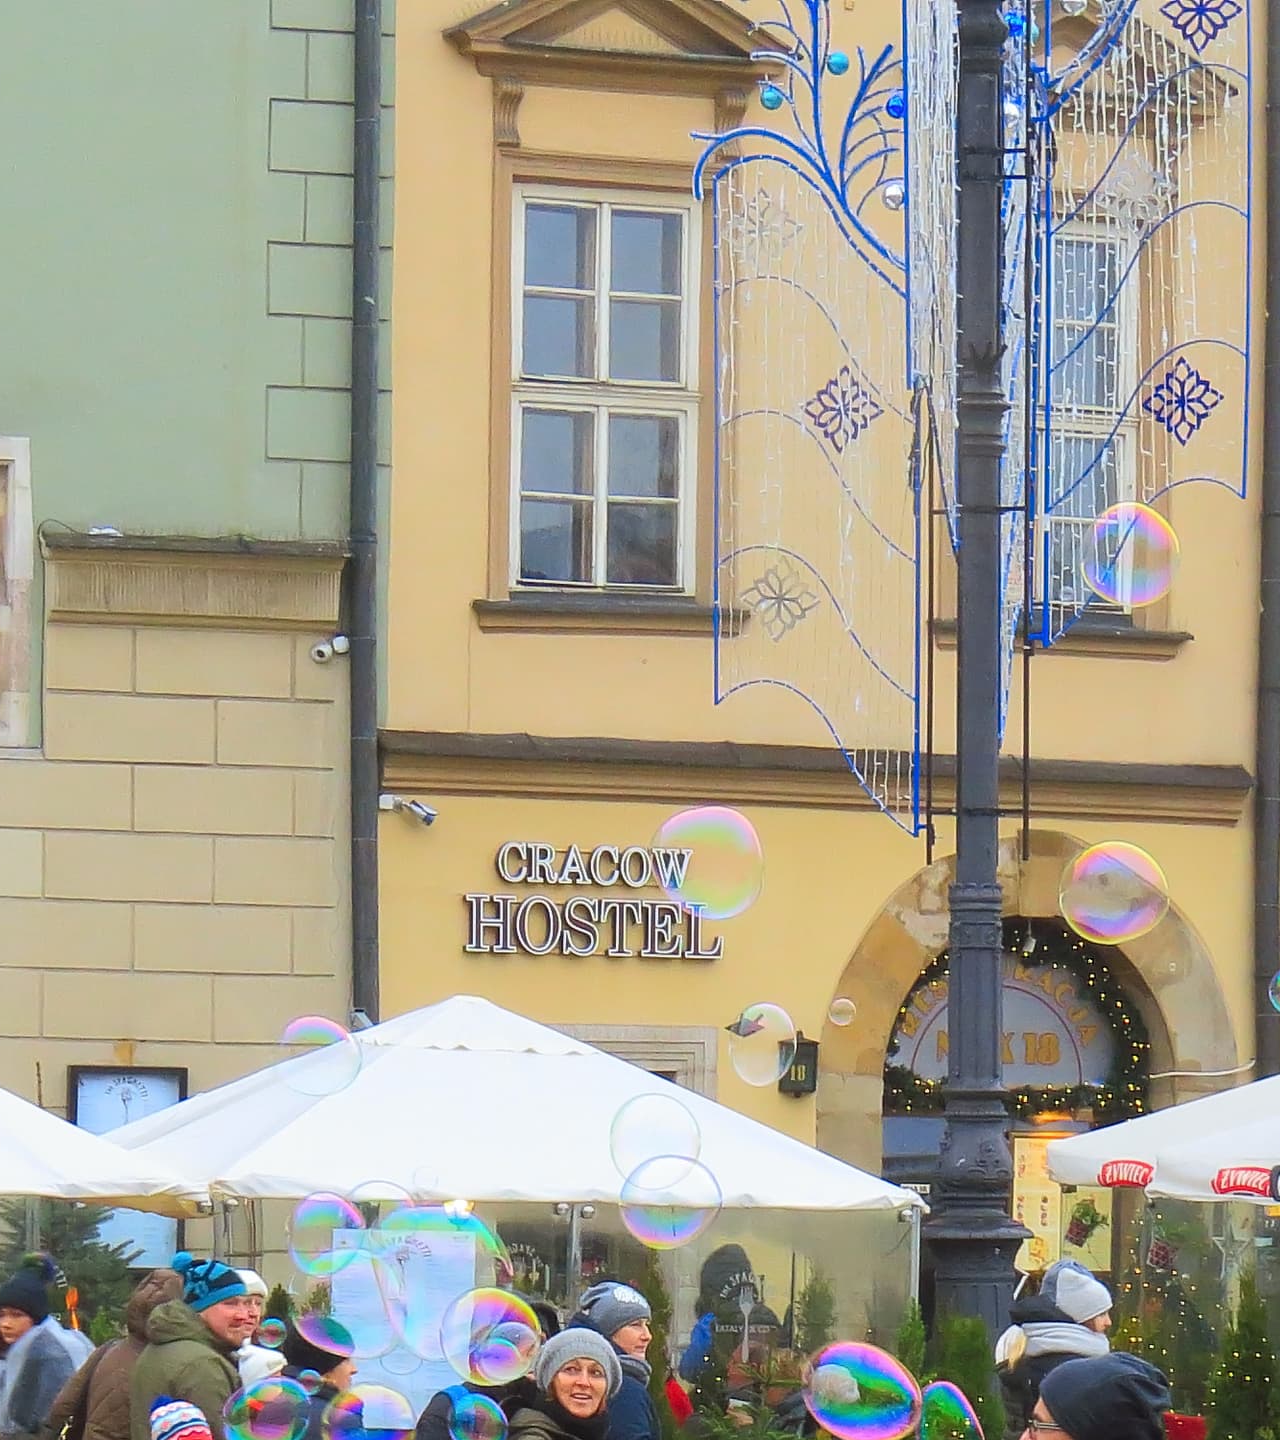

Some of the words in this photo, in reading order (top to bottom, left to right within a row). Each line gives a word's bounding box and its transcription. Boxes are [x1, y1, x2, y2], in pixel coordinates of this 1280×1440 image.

[496, 840, 694, 890] CRACOW
[464, 892, 724, 960] HOSTEL
[1023, 1032, 1060, 1065] 18
[790, 1063, 806, 1081] 18
